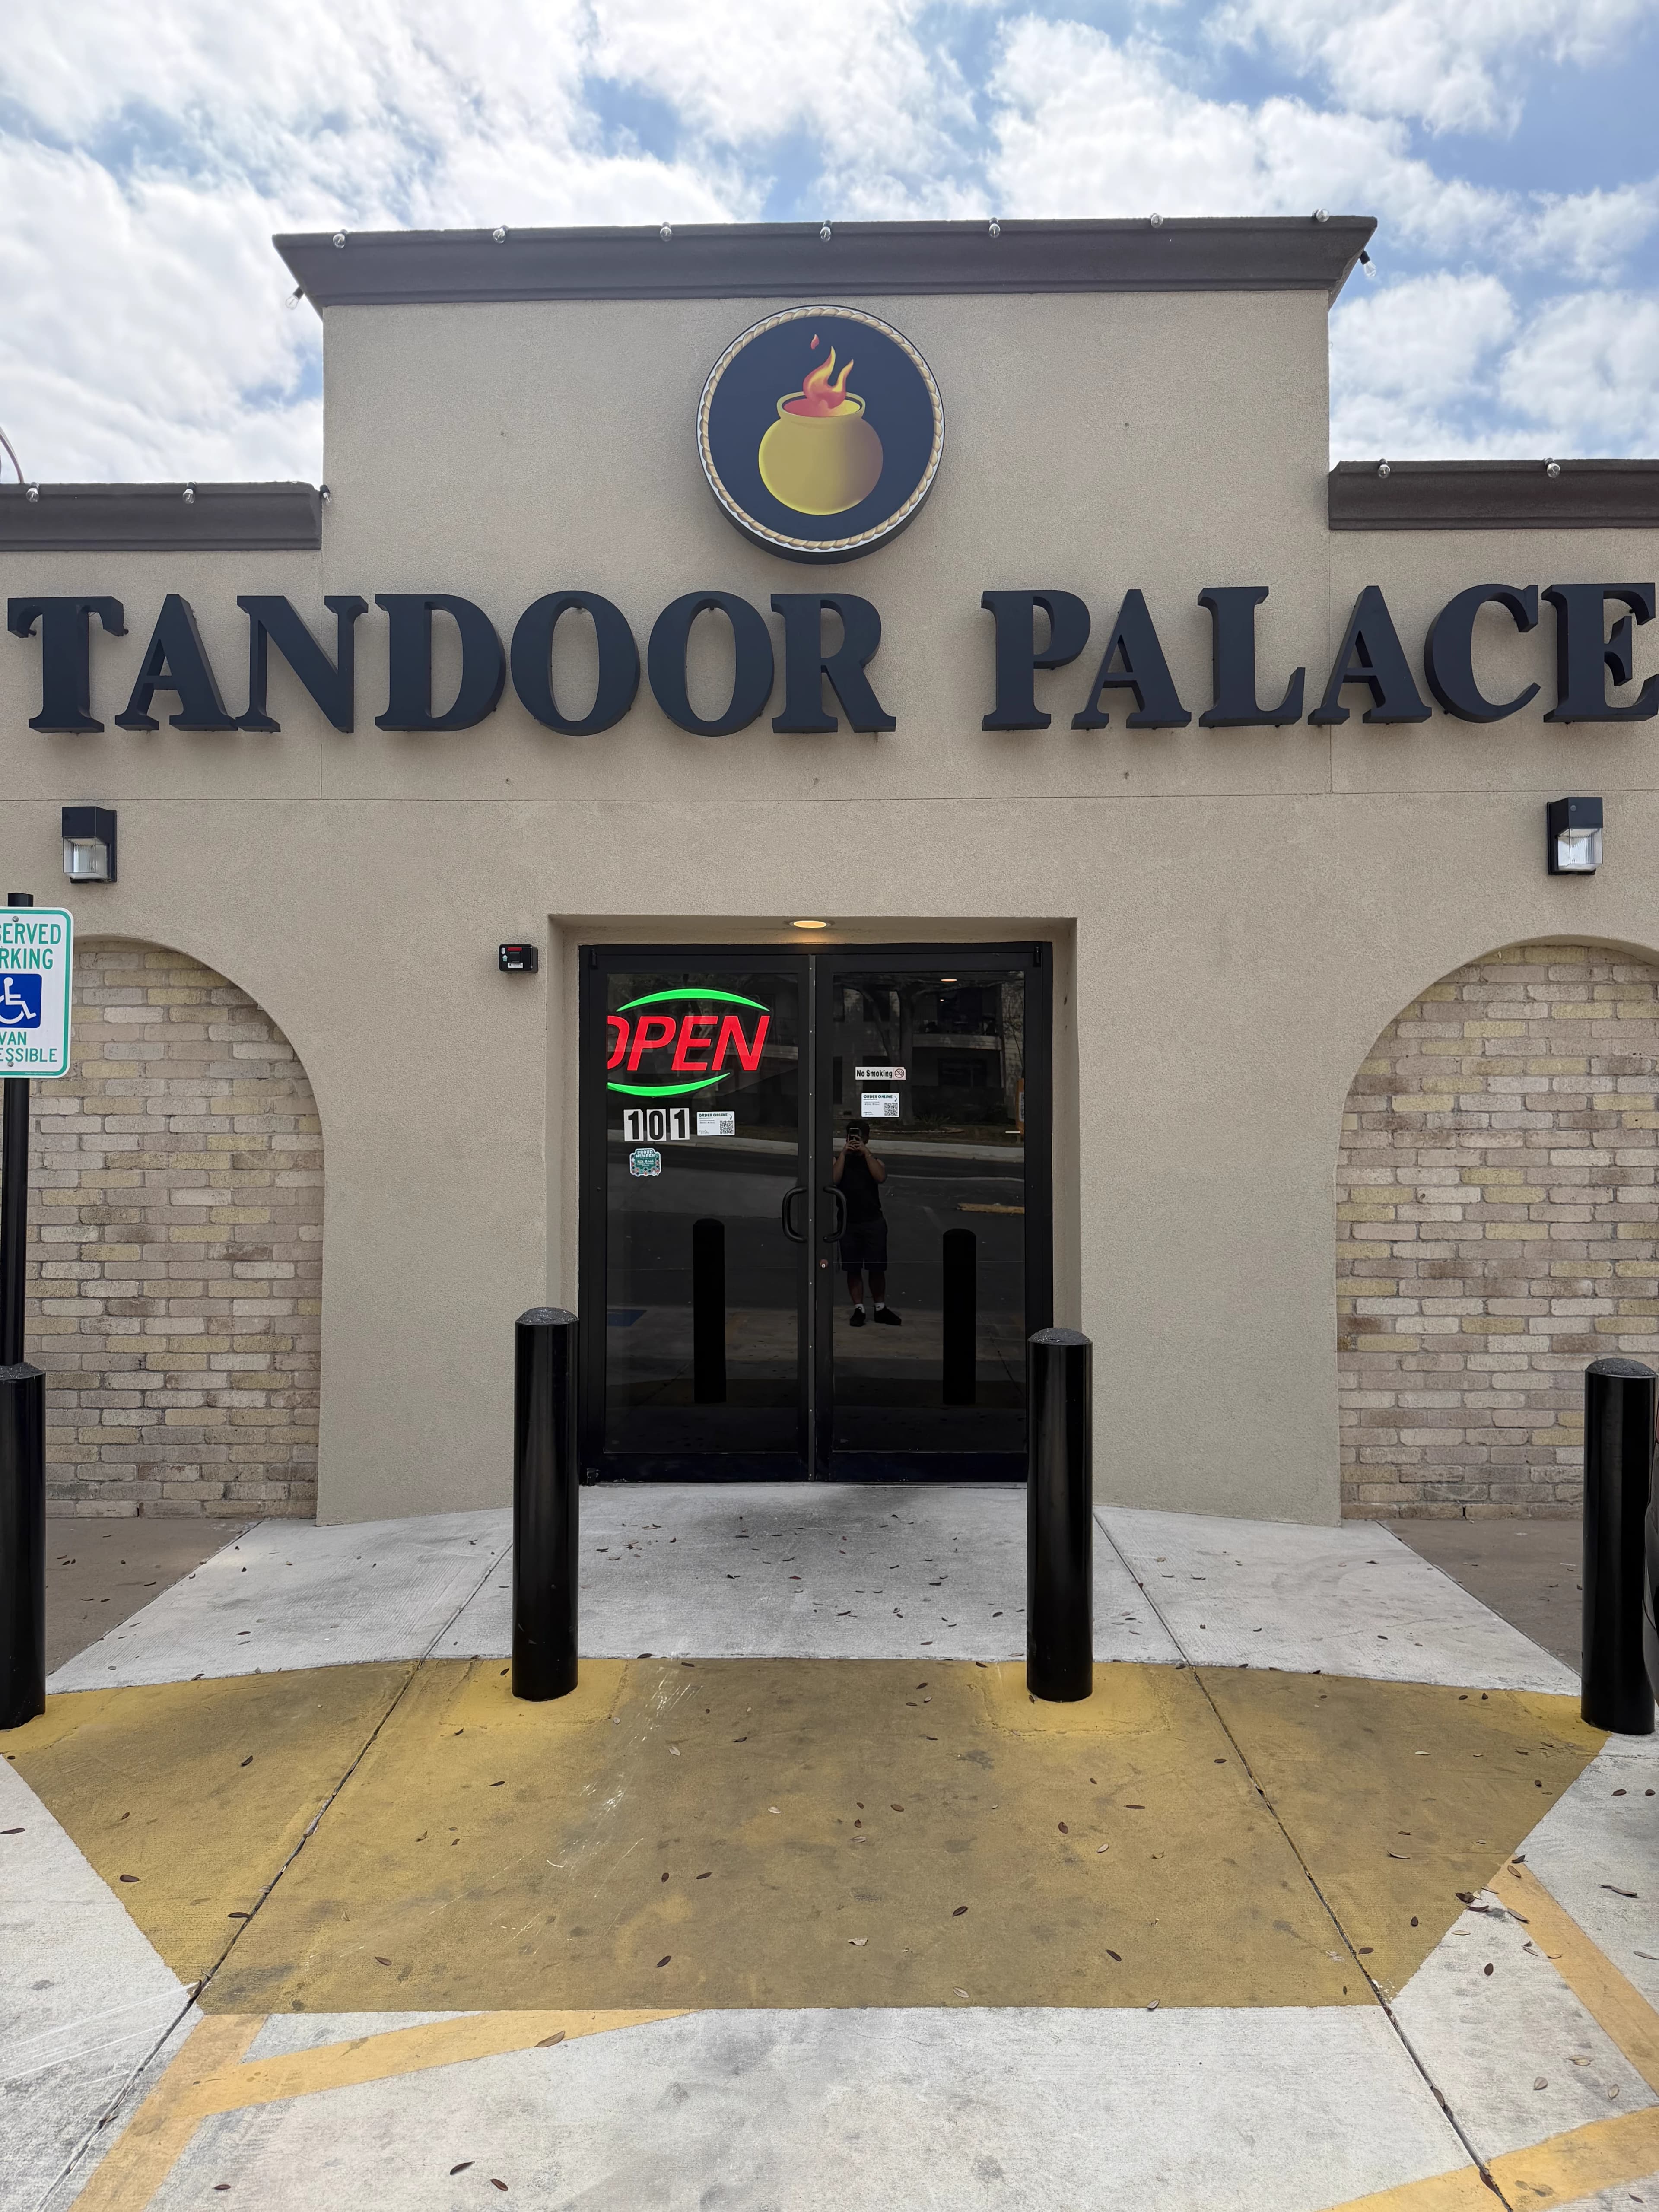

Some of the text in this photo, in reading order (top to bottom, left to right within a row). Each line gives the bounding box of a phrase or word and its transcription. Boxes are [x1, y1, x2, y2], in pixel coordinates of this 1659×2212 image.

[6, 582, 1659, 736] TANDOOR PALACE
[0, 923, 61, 944] ERVED
[0, 1031, 27, 1045] VAN
[866, 1069, 893, 1079] Smoking
[628, 1109, 686, 1141] 101
